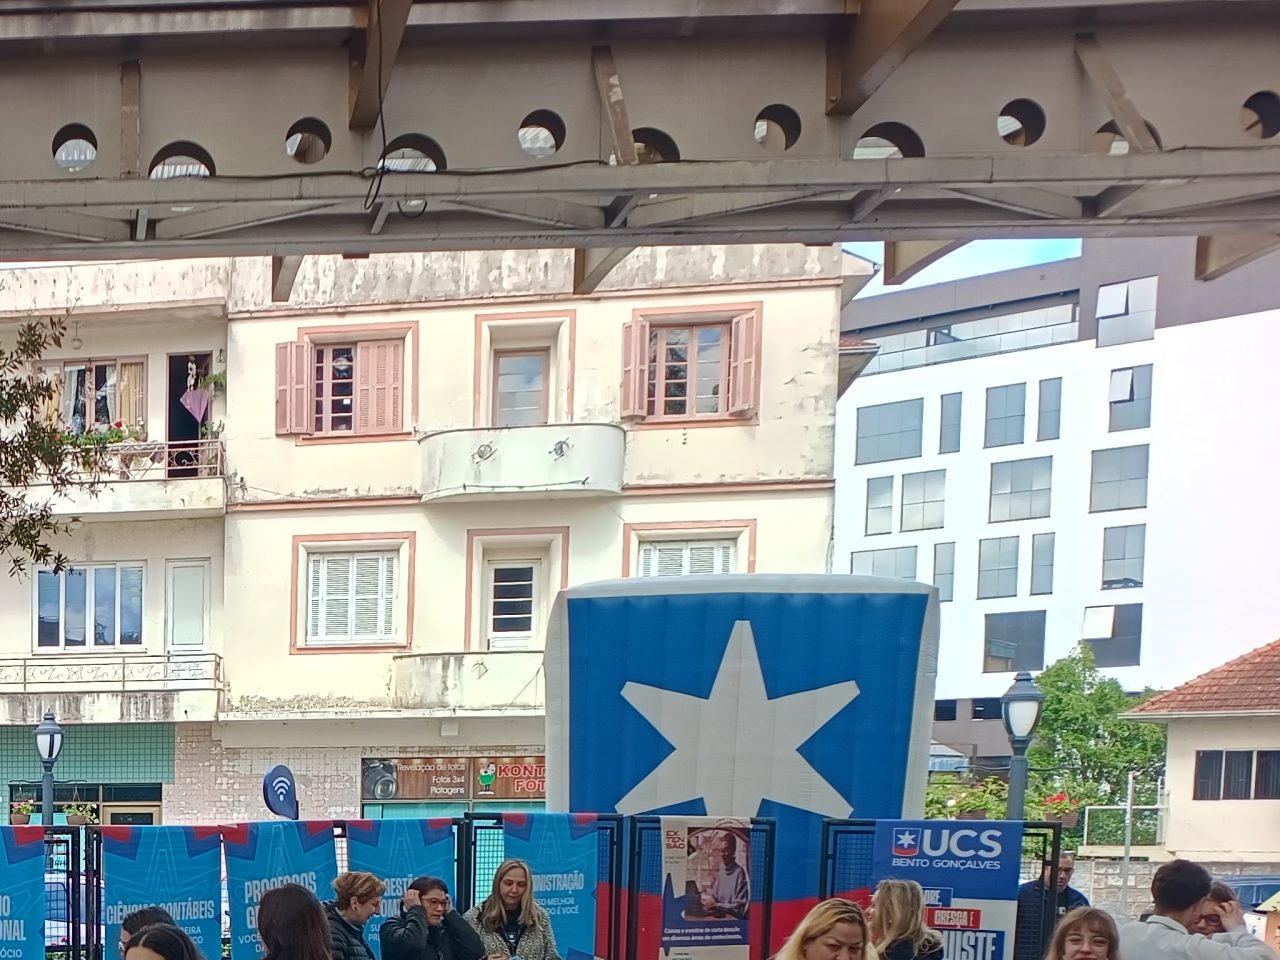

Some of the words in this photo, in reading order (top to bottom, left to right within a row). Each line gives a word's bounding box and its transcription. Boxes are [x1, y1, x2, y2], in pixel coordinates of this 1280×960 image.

[497, 764, 545, 777] KONT
[432, 775, 451, 784] Fotos
[452, 775, 465, 784] 3x4
[515, 779, 546, 792] FOT
[922, 829, 1002, 858] UCS
[892, 858, 930, 868] BENTO
[933, 859, 1001, 870] GONÇALVES
[934, 909, 968, 929] CRESÇA
